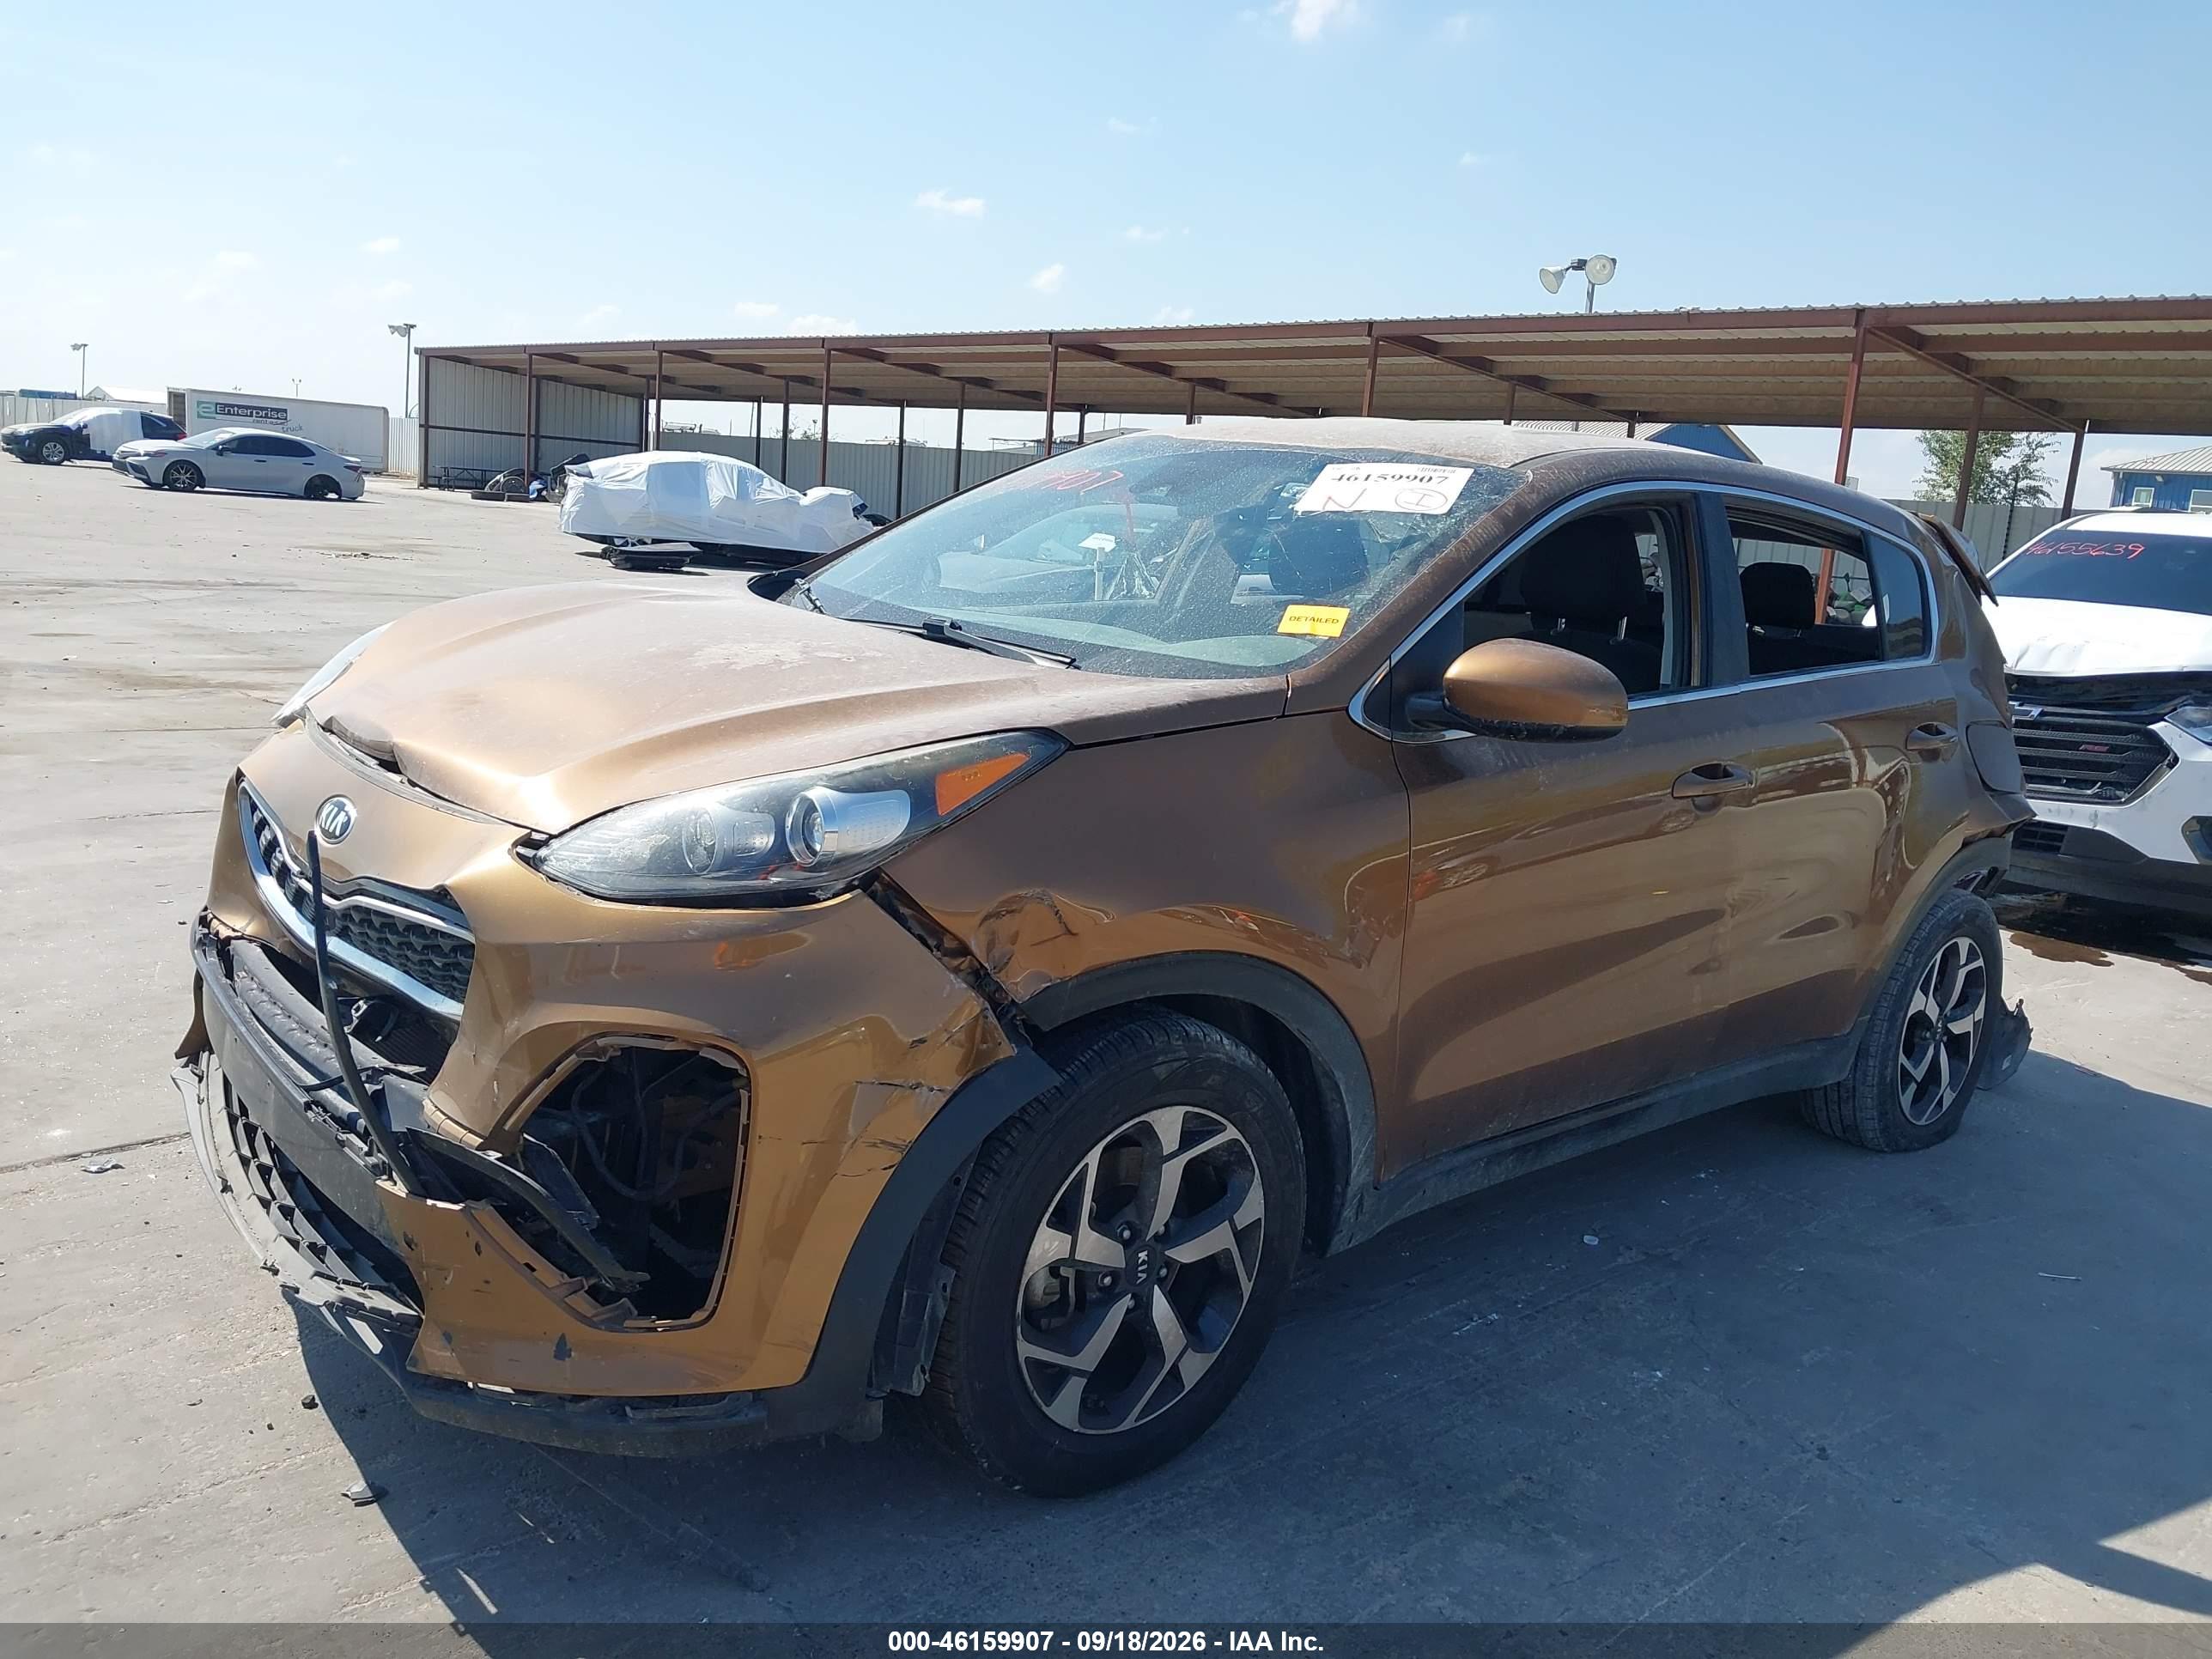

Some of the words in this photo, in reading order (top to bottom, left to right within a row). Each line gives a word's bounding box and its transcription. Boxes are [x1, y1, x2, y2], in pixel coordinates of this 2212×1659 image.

[216, 404, 287, 418] Enterprise
[282, 424, 303, 433] truck
[1332, 474, 1449, 484] 46159907
[1289, 616, 1340, 624] DETAILED
[319, 803, 348, 836] KIA
[1136, 1250, 1148, 1285] KIA
